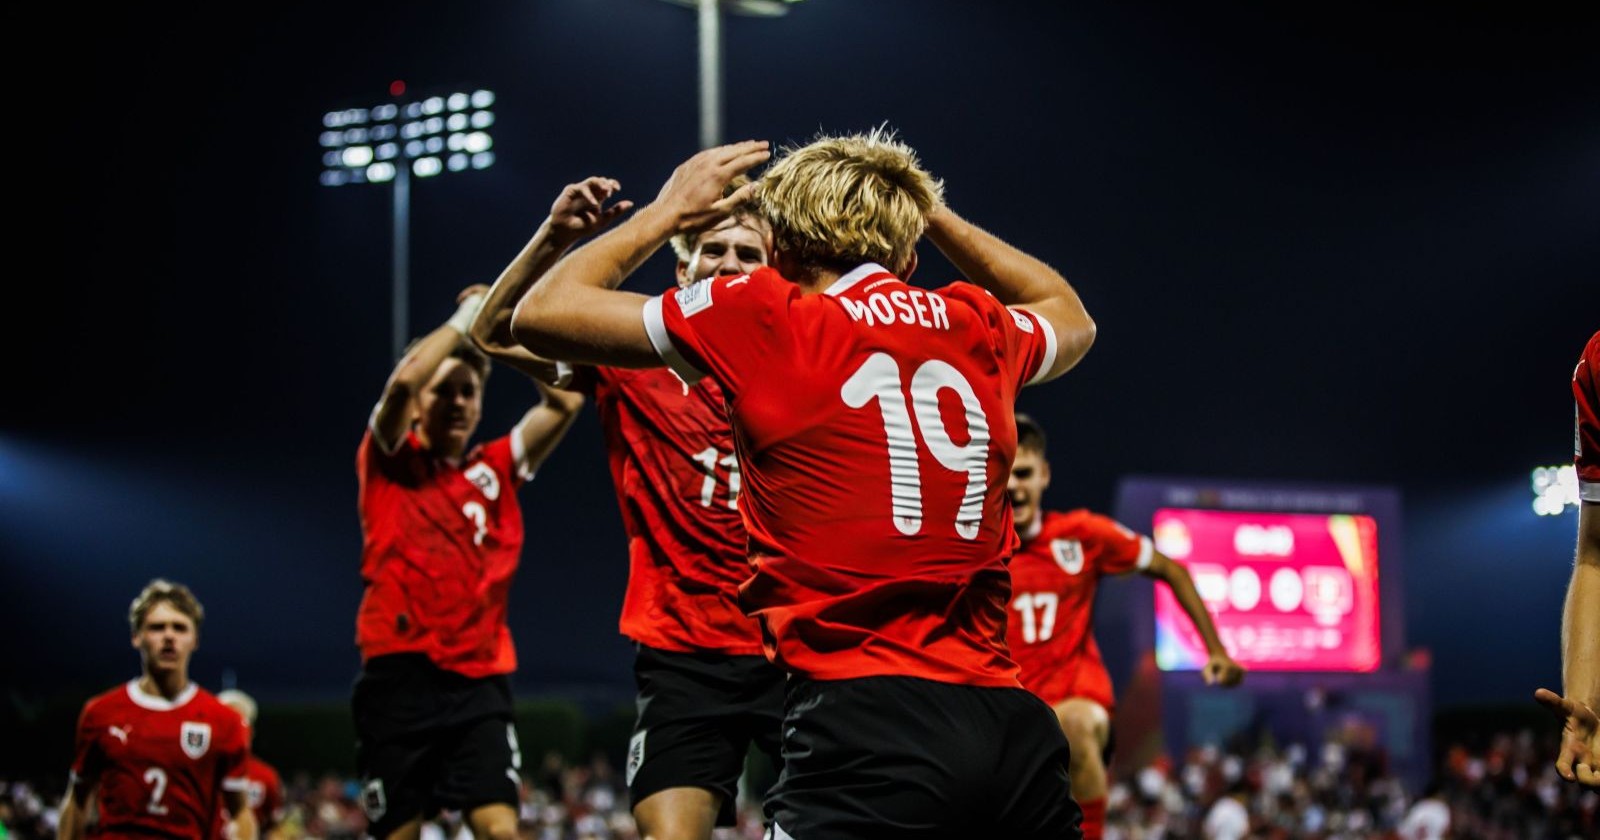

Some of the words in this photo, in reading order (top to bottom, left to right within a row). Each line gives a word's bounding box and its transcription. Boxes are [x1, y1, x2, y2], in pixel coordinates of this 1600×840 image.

[839, 289, 951, 331] MOSER
[840, 351, 991, 540] 19
[691, 446, 742, 511] 11
[1013, 592, 1059, 644] 17
[143, 767, 169, 815] 2
